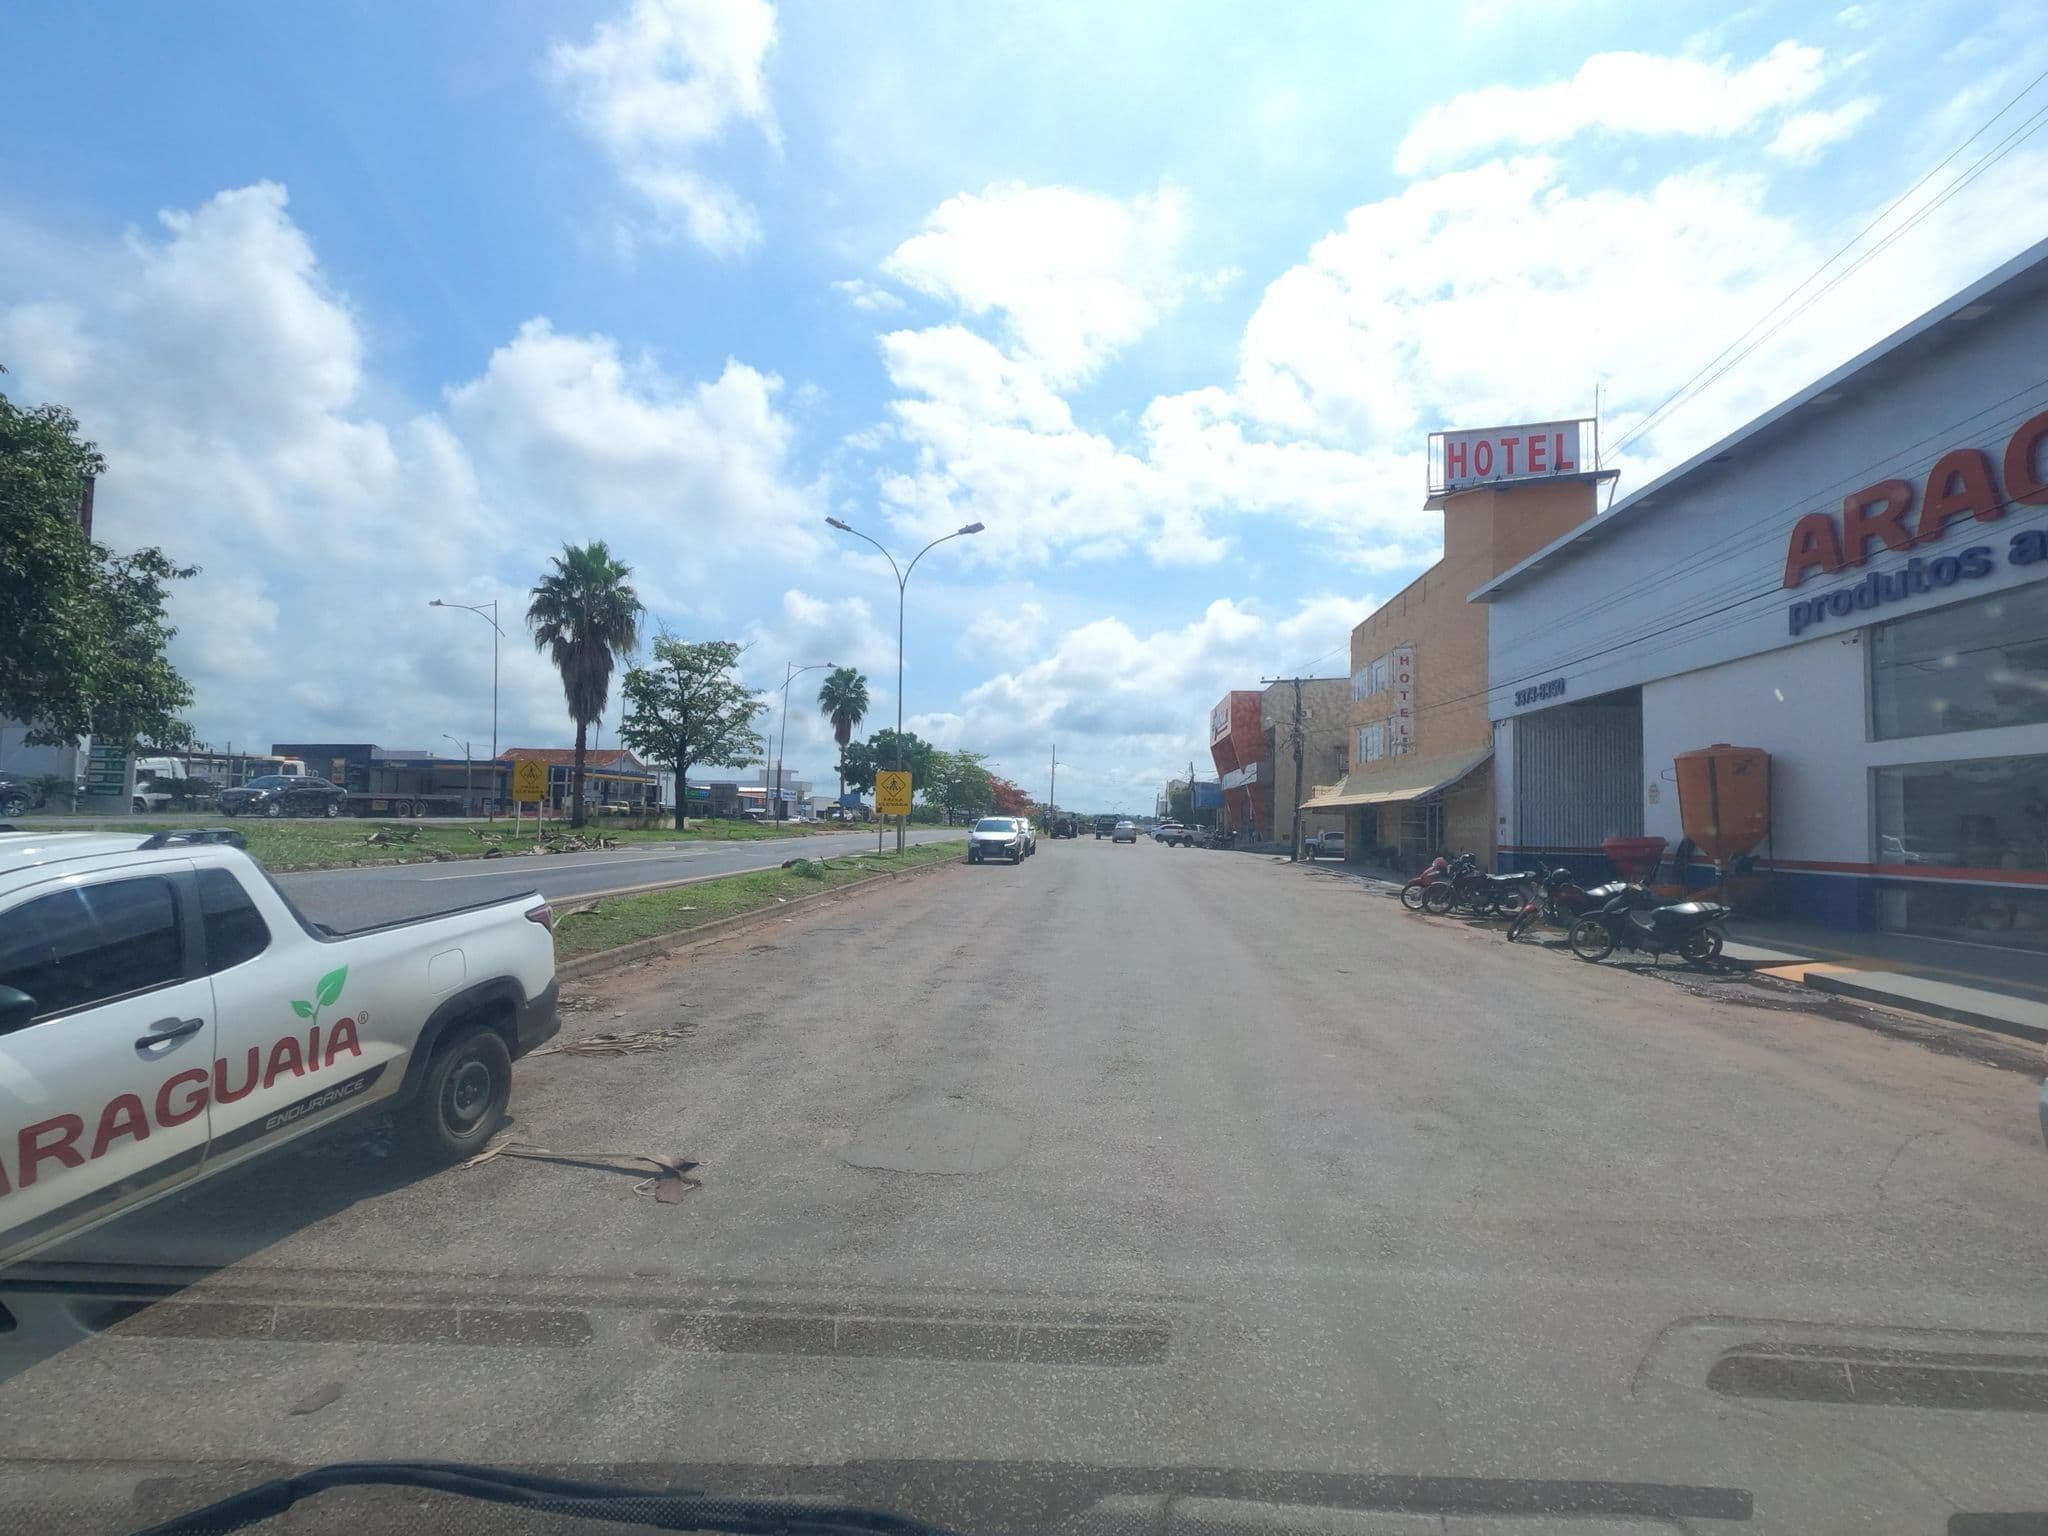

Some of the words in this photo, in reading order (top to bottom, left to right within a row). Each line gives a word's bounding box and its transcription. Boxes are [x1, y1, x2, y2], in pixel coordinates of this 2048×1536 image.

[1447, 432, 1575, 480] HOTEL
[1788, 545, 1996, 637] produtos
[1399, 655, 1410, 736] HOTEL
[265, 1078, 365, 1131] ENDURANCE
